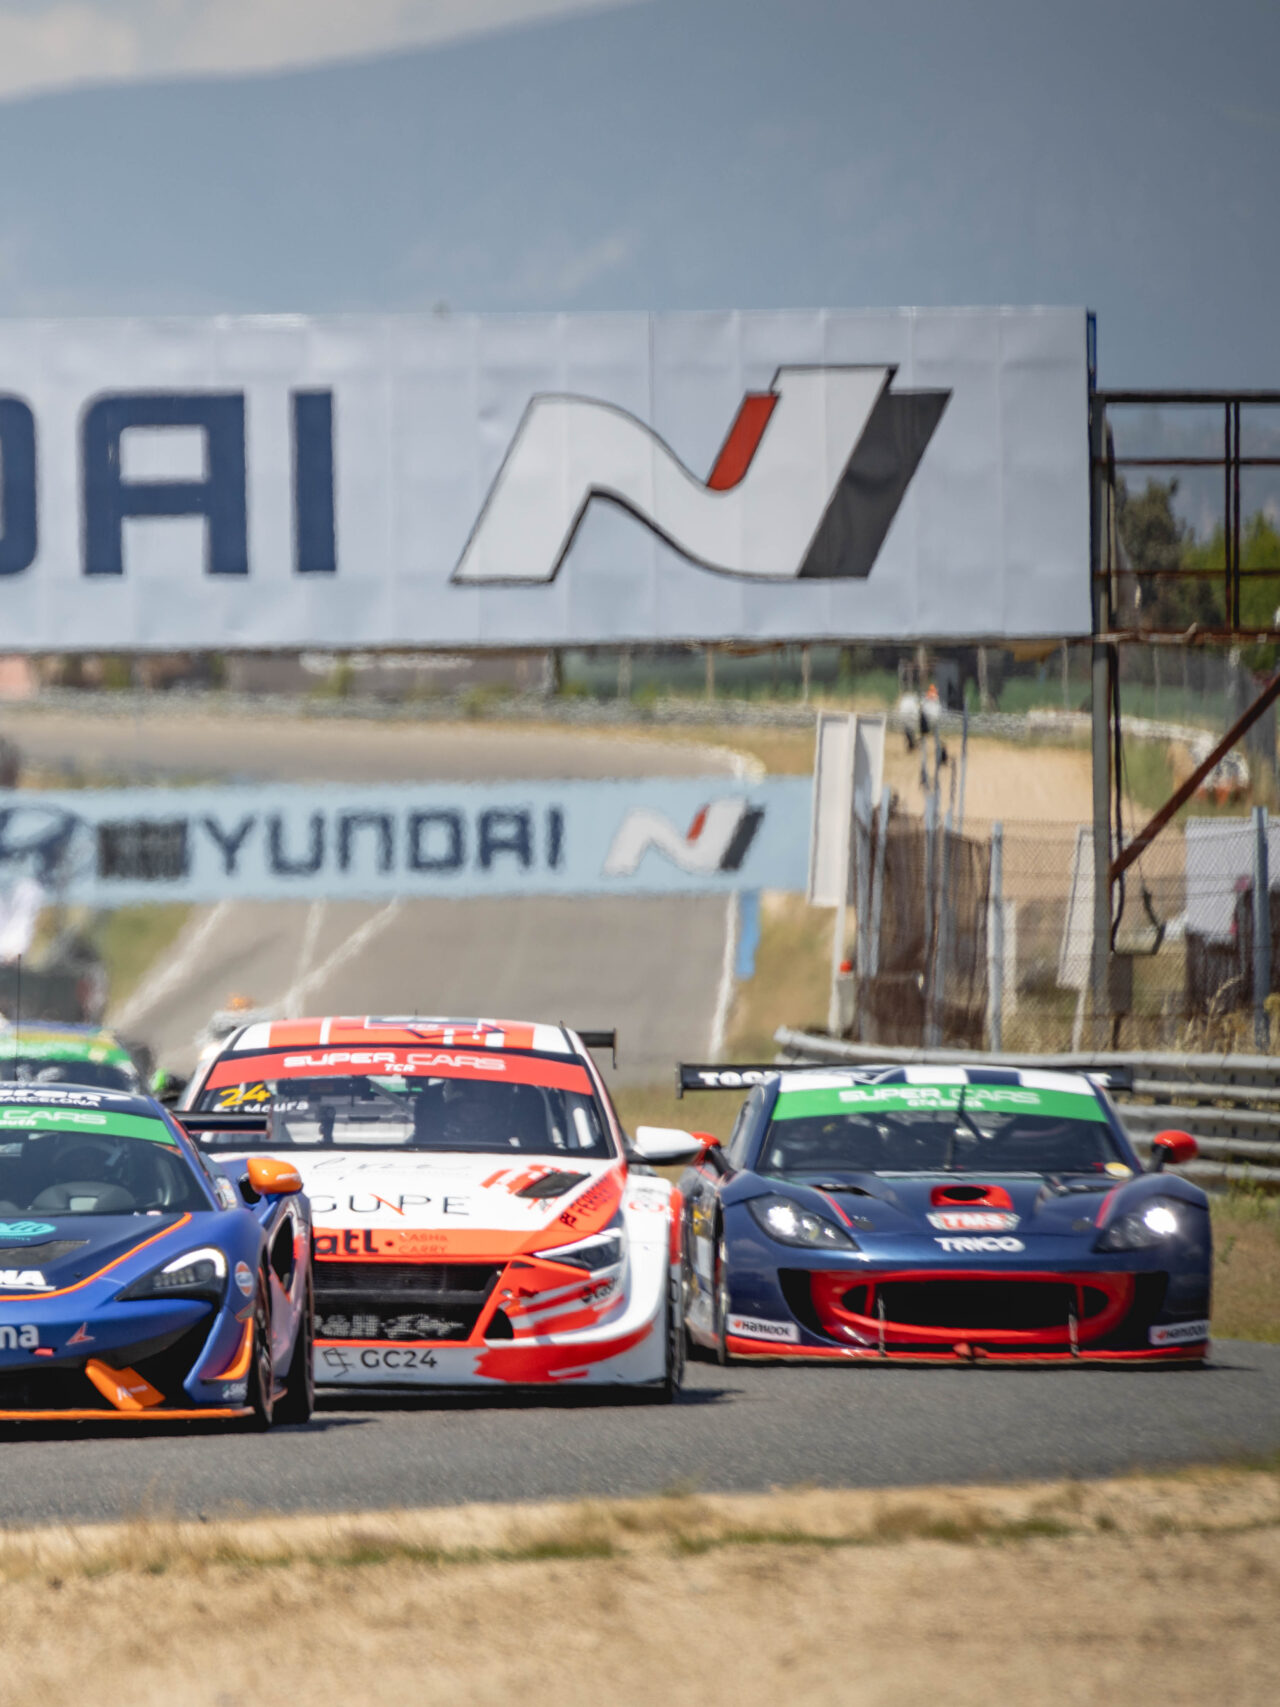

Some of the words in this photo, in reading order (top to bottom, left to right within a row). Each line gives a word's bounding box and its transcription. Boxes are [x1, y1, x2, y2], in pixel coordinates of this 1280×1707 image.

[178, 804, 566, 876] YUNDAI
[283, 1052, 396, 1067] SUPER
[406, 1053, 507, 1071] CARS
[384, 1063, 415, 1072] TCR
[219, 1083, 271, 1107] 24
[839, 1089, 941, 1103] SUPER
[949, 1089, 1041, 1104] CARS
[245, 1100, 309, 1112] Moura
[2, 1110, 108, 1126] CARS
[934, 1236, 1026, 1252] TRICO
[360, 1349, 438, 1369] GC24
